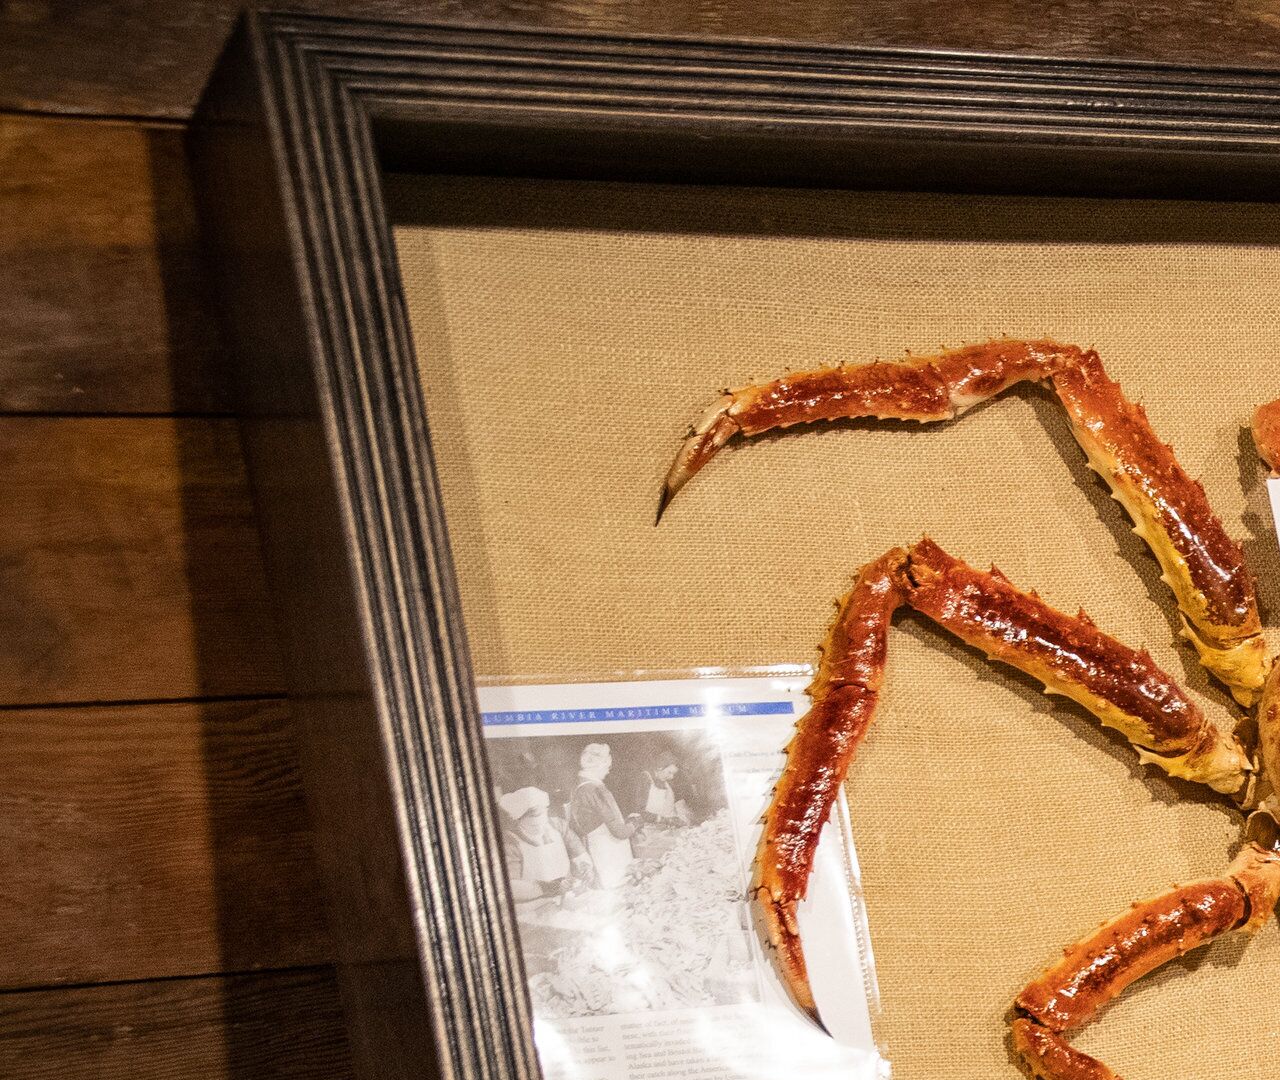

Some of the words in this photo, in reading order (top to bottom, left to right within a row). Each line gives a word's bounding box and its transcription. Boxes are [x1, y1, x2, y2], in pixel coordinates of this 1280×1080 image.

[482, 713, 542, 724] LUMBIA
[551, 711, 597, 721] RIVER
[605, 707, 680, 720] MARITIME
